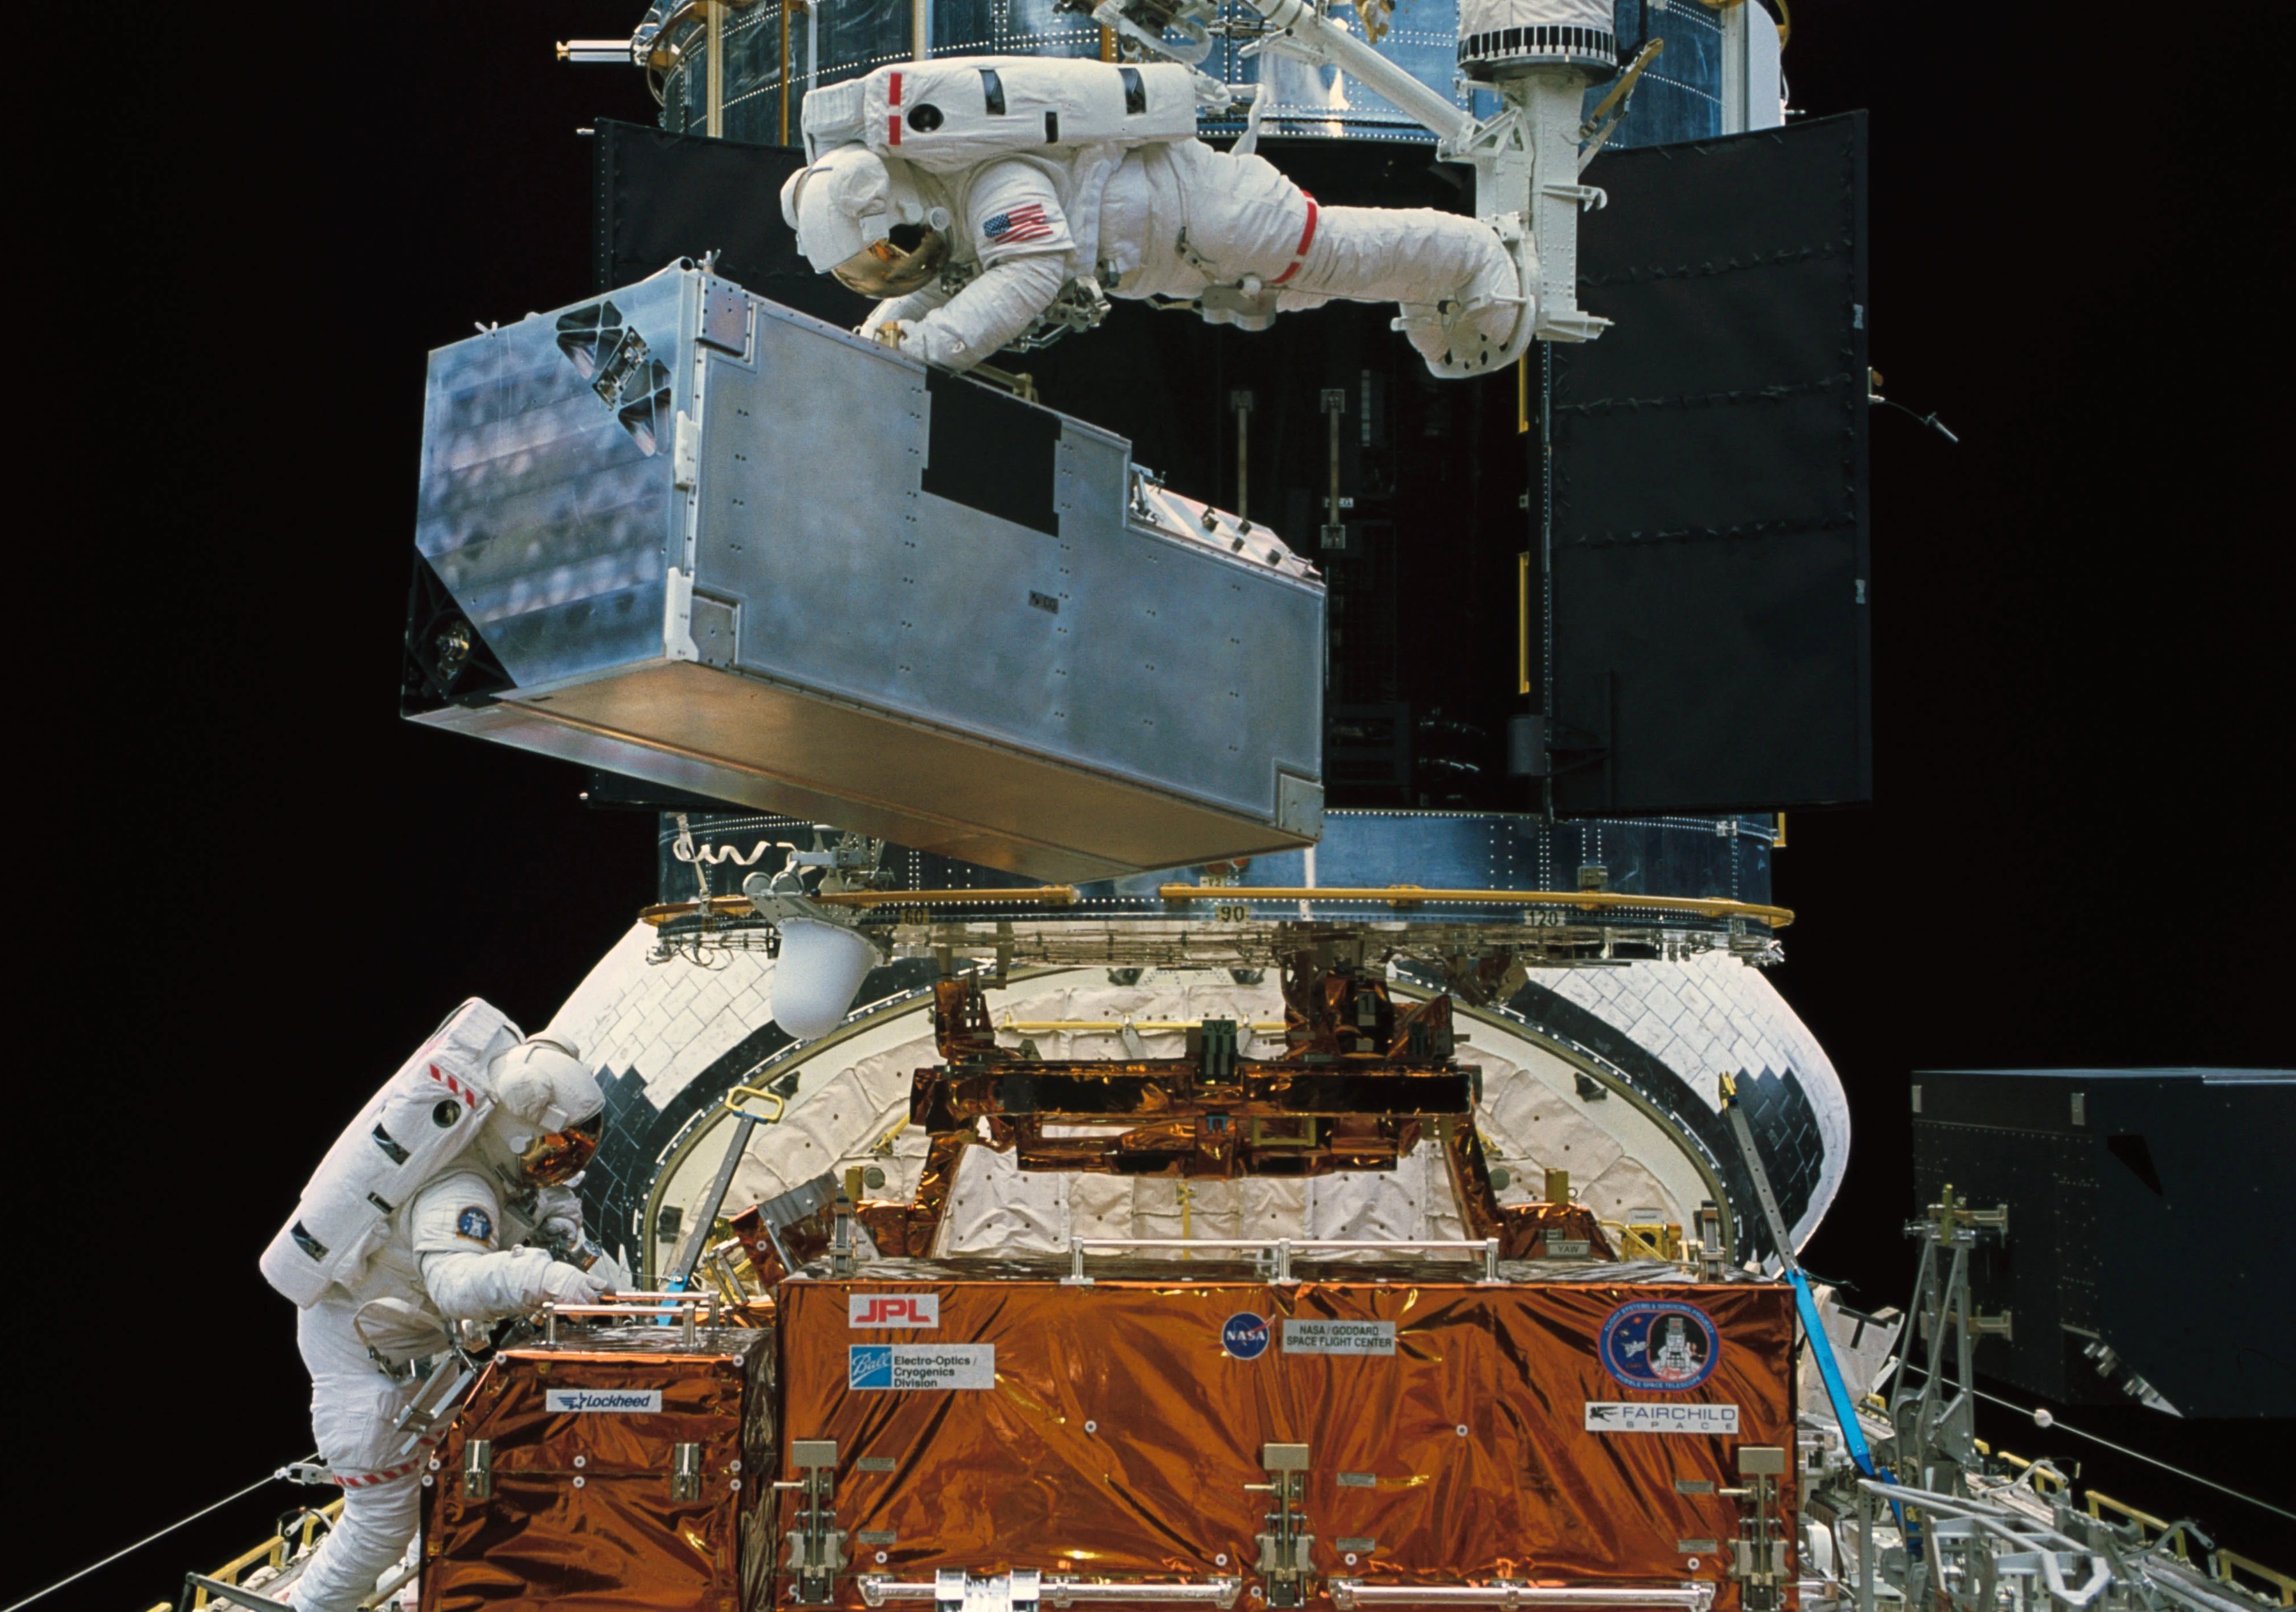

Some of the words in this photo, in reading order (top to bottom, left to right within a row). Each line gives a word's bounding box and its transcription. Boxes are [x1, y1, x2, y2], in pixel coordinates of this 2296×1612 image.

[905, 909, 924, 925] 60
[1221, 906, 1245, 923] 90
[1529, 911, 1559, 926] 120
[1207, 1022, 1232, 1035] -V2
[1558, 1245, 1580, 1253] YAW
[854, 1298, 932, 1323] JPL
[1226, 1330, 1265, 1341] NASA
[1299, 1325, 1325, 1335] NASA
[1332, 1326, 1379, 1336] GODDARD
[1286, 1336, 1317, 1347] SPACE
[1320, 1337, 1352, 1347] FLIGHT
[1354, 1338, 1392, 1348] CENTER
[851, 1351, 892, 1377] Ball
[894, 1356, 971, 1366] Electro-Optics
[894, 1367, 955, 1380] Cryogenics
[894, 1378, 938, 1388] Division
[586, 1394, 651, 1407] Lockheed
[1622, 1406, 1736, 1421] FAIRCHILD
[1626, 1421, 1732, 1430] SPACE
